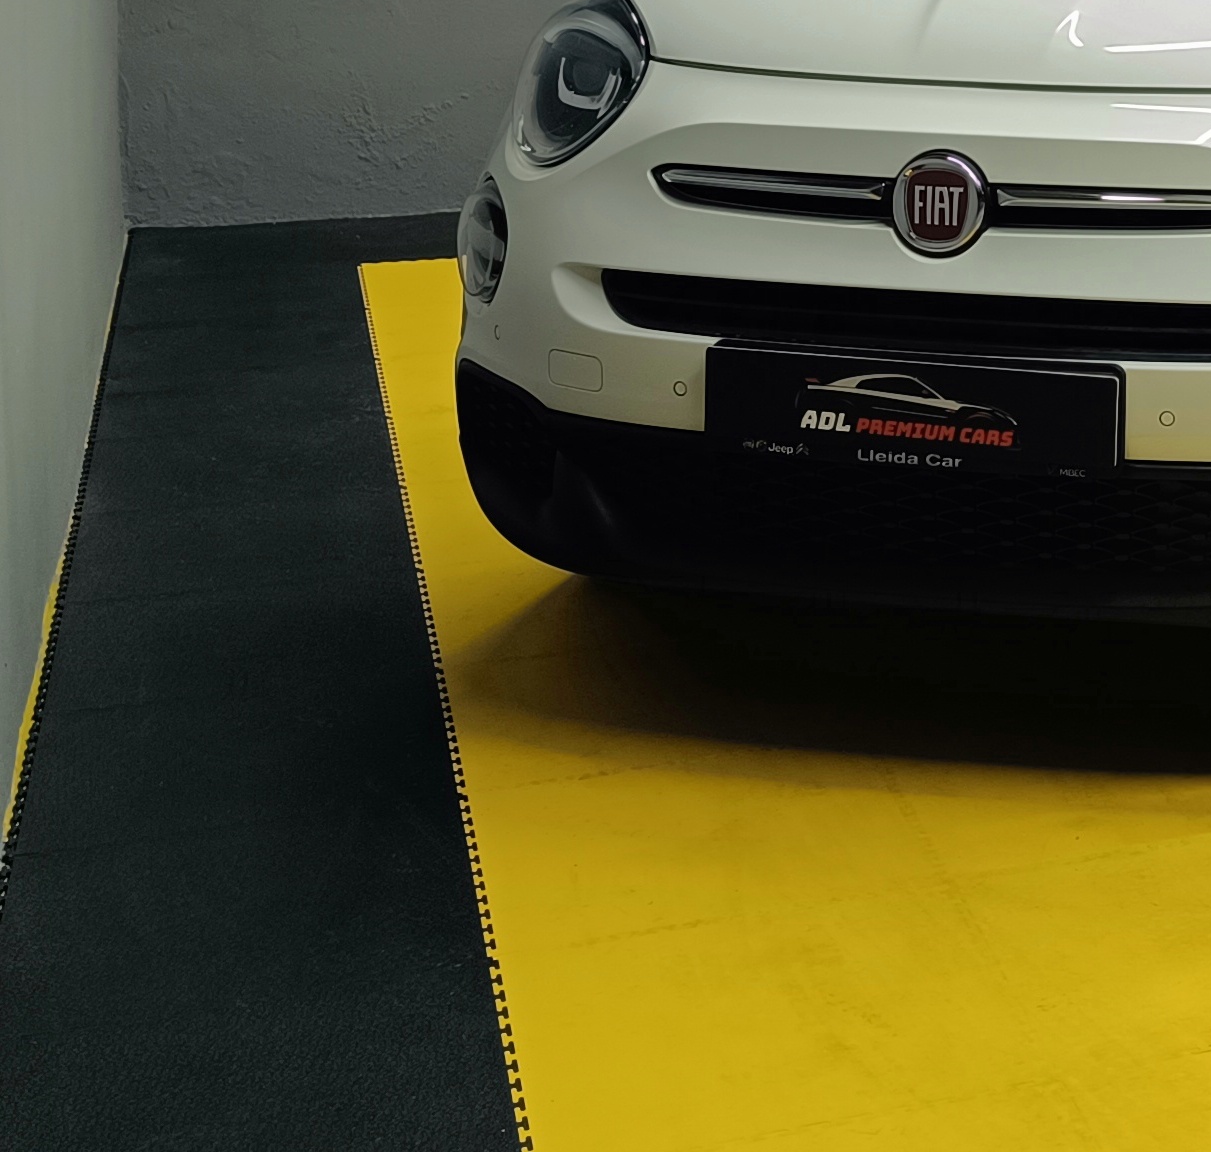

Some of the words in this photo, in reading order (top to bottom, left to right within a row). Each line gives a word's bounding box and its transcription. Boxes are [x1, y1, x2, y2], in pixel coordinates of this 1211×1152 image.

[913, 184, 964, 226] FIAT
[800, 409, 851, 433] ADL
[856, 417, 956, 442] PREMIUM
[959, 426, 1015, 447] CARS
[767, 442, 794, 455] Jeep
[857, 448, 919, 466] Lleida
[925, 452, 963, 469] Car
